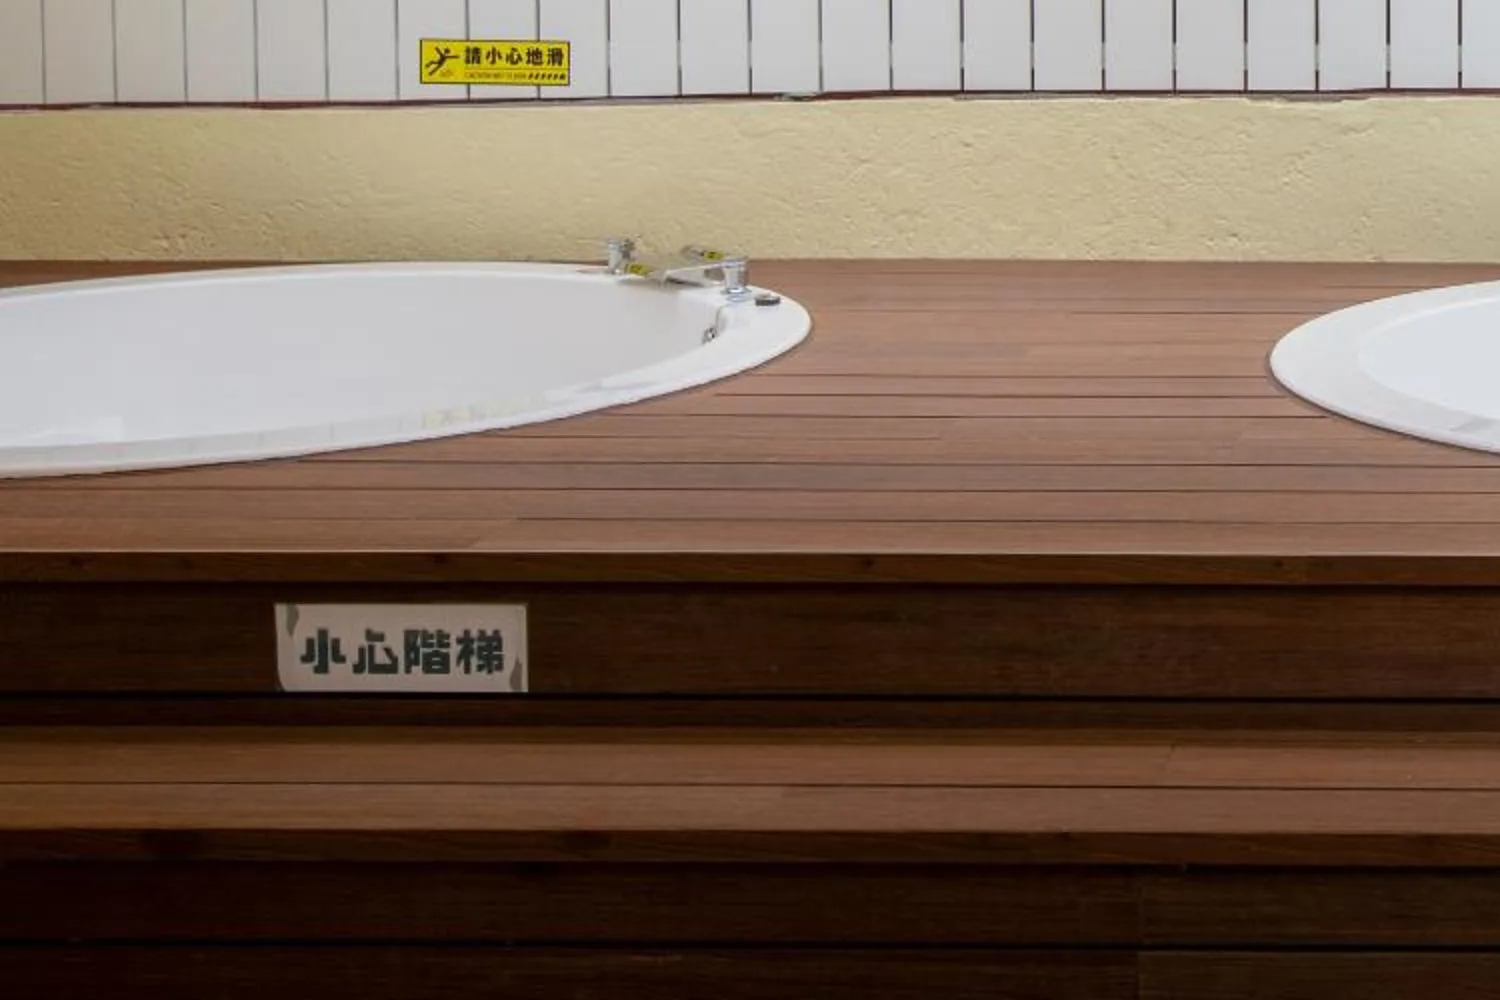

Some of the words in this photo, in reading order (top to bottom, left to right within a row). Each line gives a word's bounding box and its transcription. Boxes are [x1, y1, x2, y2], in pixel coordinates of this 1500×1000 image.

[464, 46, 564, 66] 請小心地滑
[300, 628, 504, 675] 小心階梯
